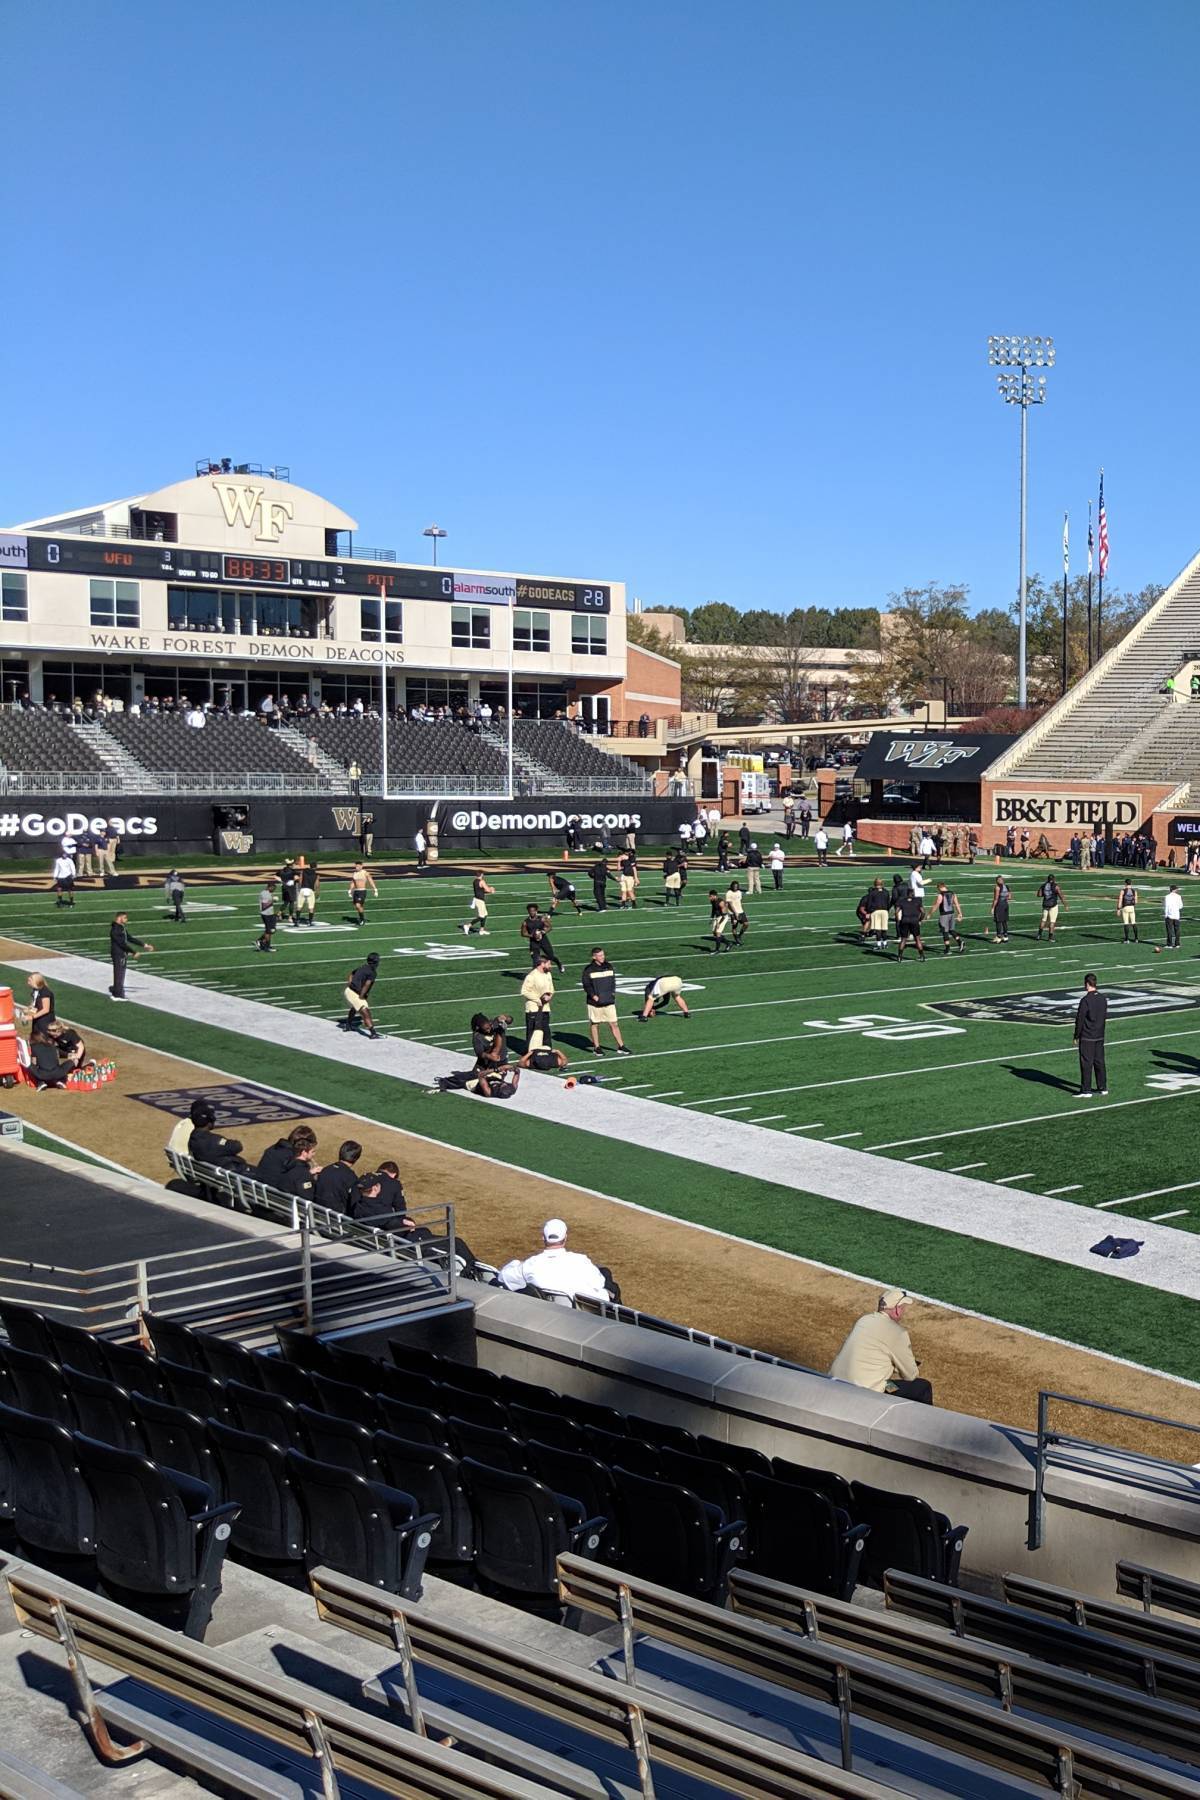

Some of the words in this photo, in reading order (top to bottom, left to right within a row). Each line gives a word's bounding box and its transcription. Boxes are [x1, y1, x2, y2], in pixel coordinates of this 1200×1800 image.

[213, 481, 294, 543] WF
[47, 544, 60, 563] 0
[103, 551, 134, 566] WFU
[178, 569, 196, 577] DOWN
[367, 574, 395, 587] PITT
[441, 577, 452, 595] 0
[454, 582, 516, 597] alarmsouth
[516, 585, 576, 602] #GODEACS
[583, 589, 604, 607] 28
[90, 633, 151, 650] WAKE
[163, 638, 237, 655] FOREST
[249, 642, 315, 659] DEMON
[326, 646, 405, 664] DEACONS
[885, 740, 980, 768] WF
[452, 810, 641, 831] @DemonDeacons
[995, 797, 1063, 823] BB&T
[1066, 800, 1137, 825] FIELD
[0, 813, 158, 837] #GoDeacs
[803, 1014, 967, 1040] 50
